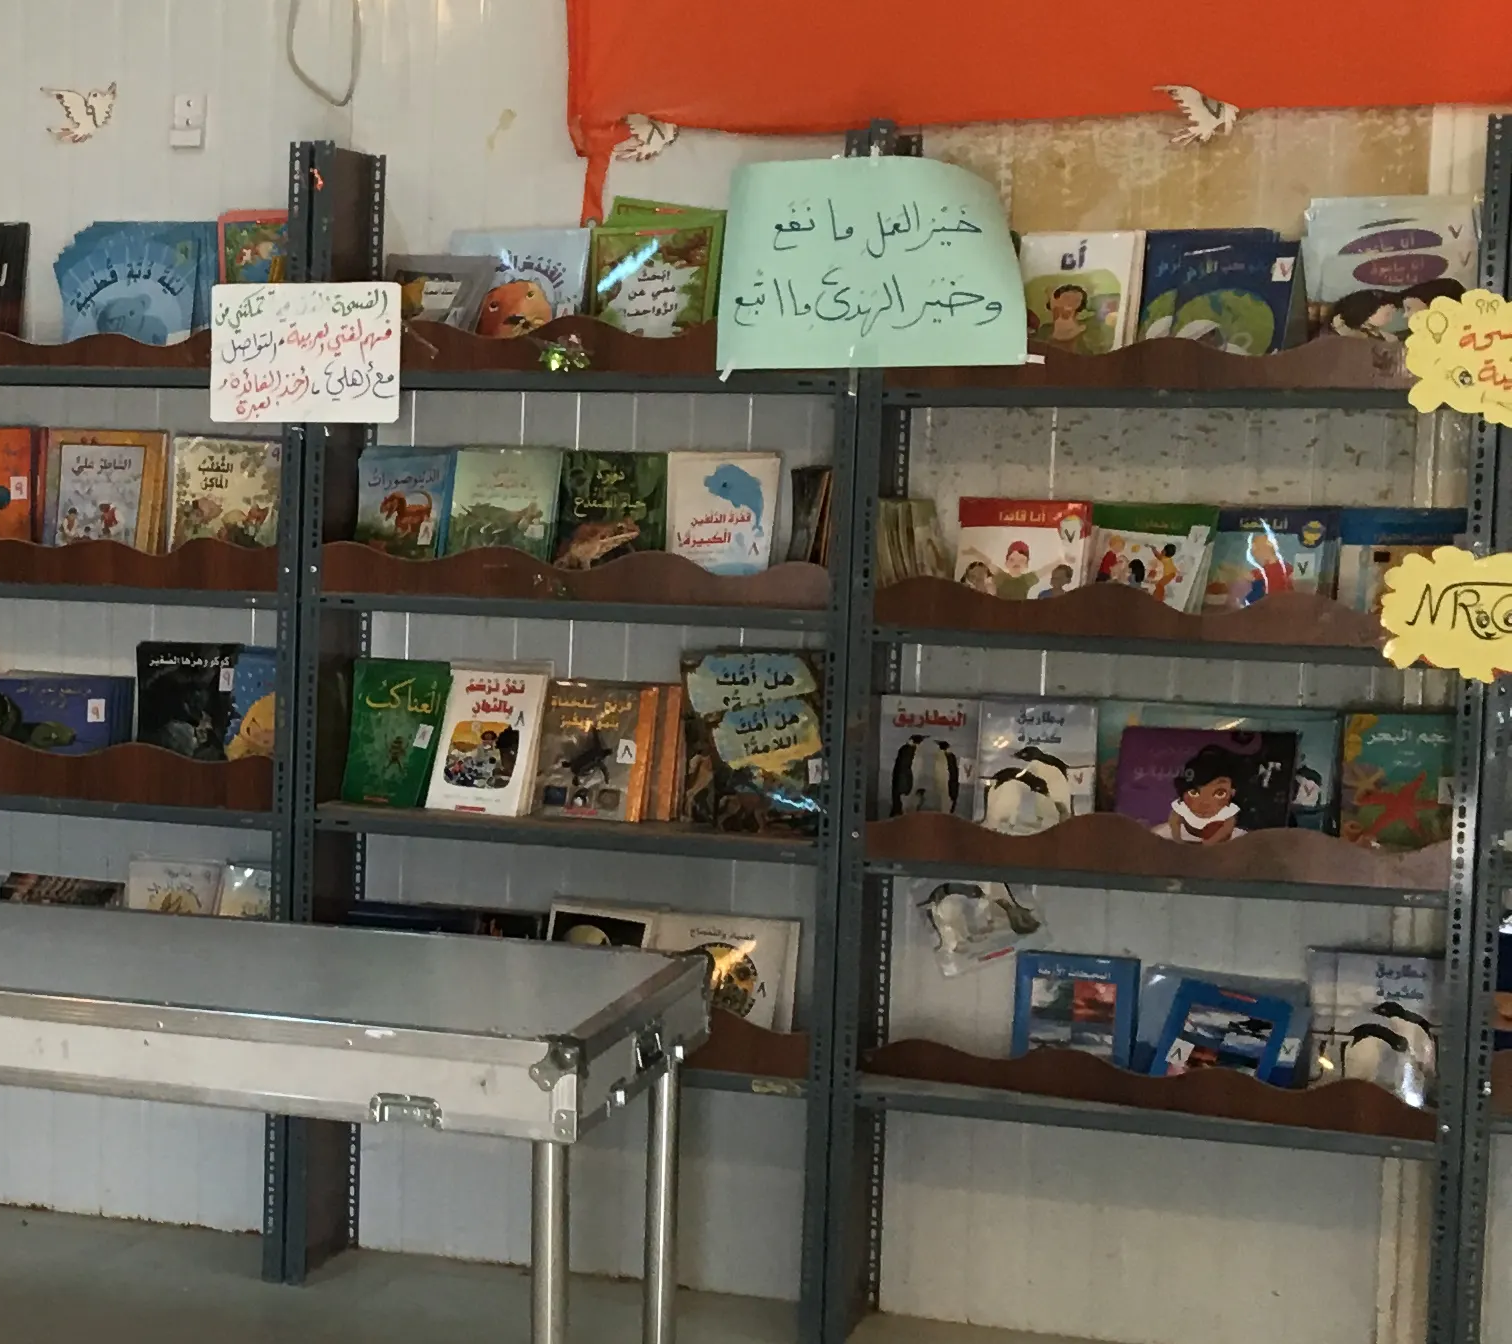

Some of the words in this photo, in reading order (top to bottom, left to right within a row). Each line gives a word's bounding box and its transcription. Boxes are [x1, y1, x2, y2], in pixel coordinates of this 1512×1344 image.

[826, 198, 854, 242] ما
[371, 374, 395, 398] مع
[198, 455, 234, 474] الثعلب
[763, 667, 795, 690] هل
[775, 711, 801, 731] هل
[892, 702, 967, 729] البطاريق
